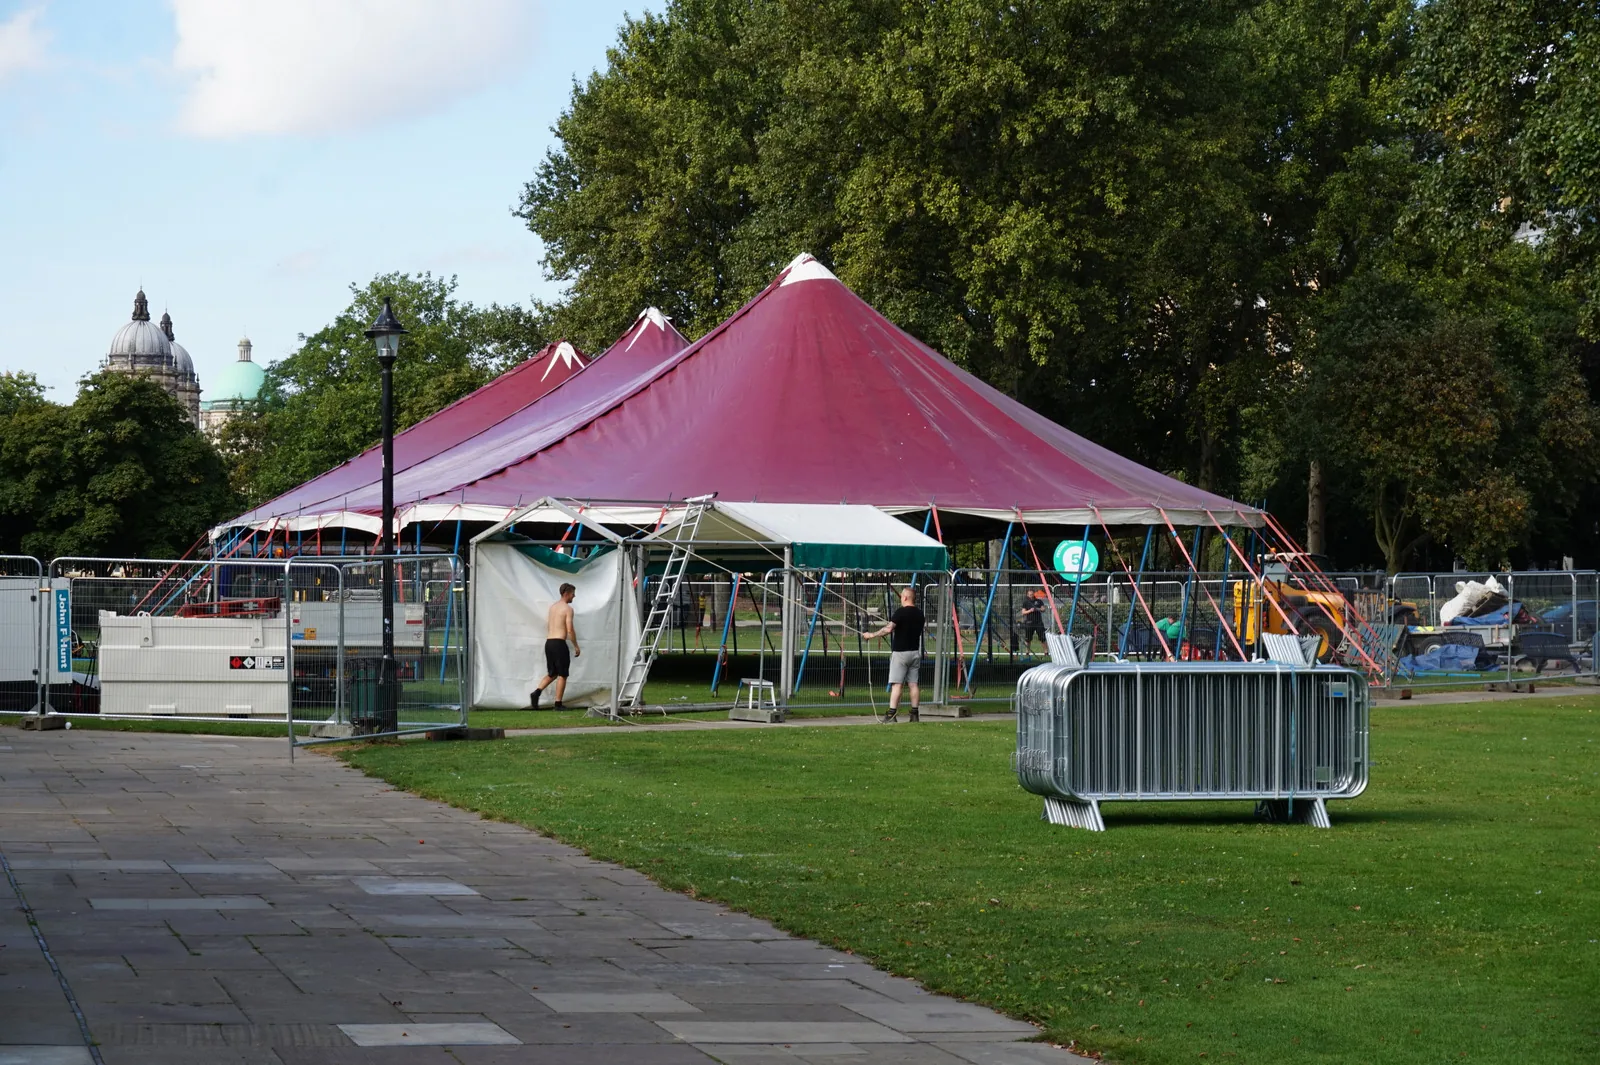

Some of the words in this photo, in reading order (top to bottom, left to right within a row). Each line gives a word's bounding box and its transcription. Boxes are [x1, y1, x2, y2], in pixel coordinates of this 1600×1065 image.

[1071, 553, 1080, 565] 5
[58, 593, 67, 625] John
[60, 627, 68, 636] F
[60, 639, 68, 669] Hunt
